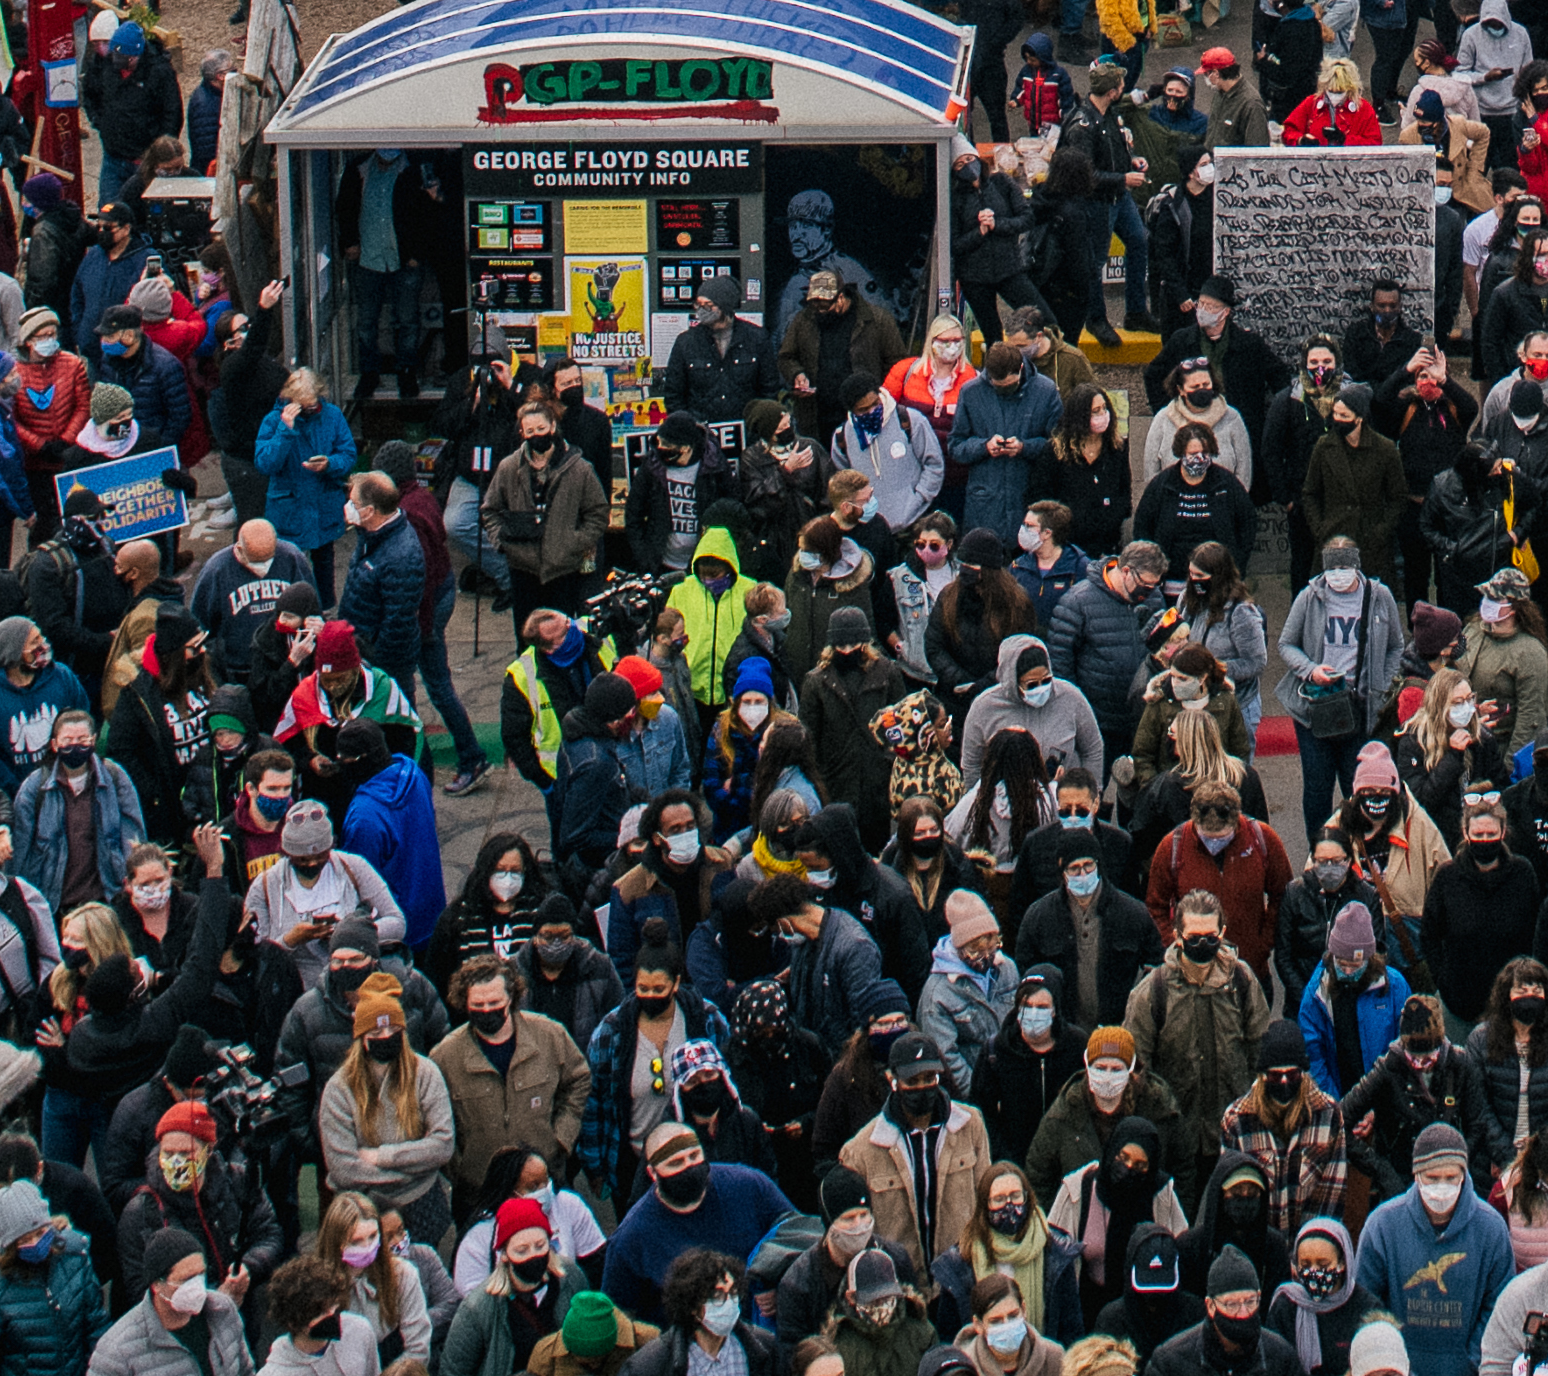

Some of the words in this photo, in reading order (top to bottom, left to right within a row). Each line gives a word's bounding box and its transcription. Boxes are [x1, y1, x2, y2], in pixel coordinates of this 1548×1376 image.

[474, 151, 567, 169] GEORGE
[574, 150, 649, 169] FLOYD
[664, 149, 750, 168] SQUARE
[534, 172, 643, 186] COMMUNITY
[650, 172, 691, 186] INFO
[593, 332, 642, 345] JUSTICE
[573, 345, 589, 358] NO
[590, 344, 645, 357] STREETS
